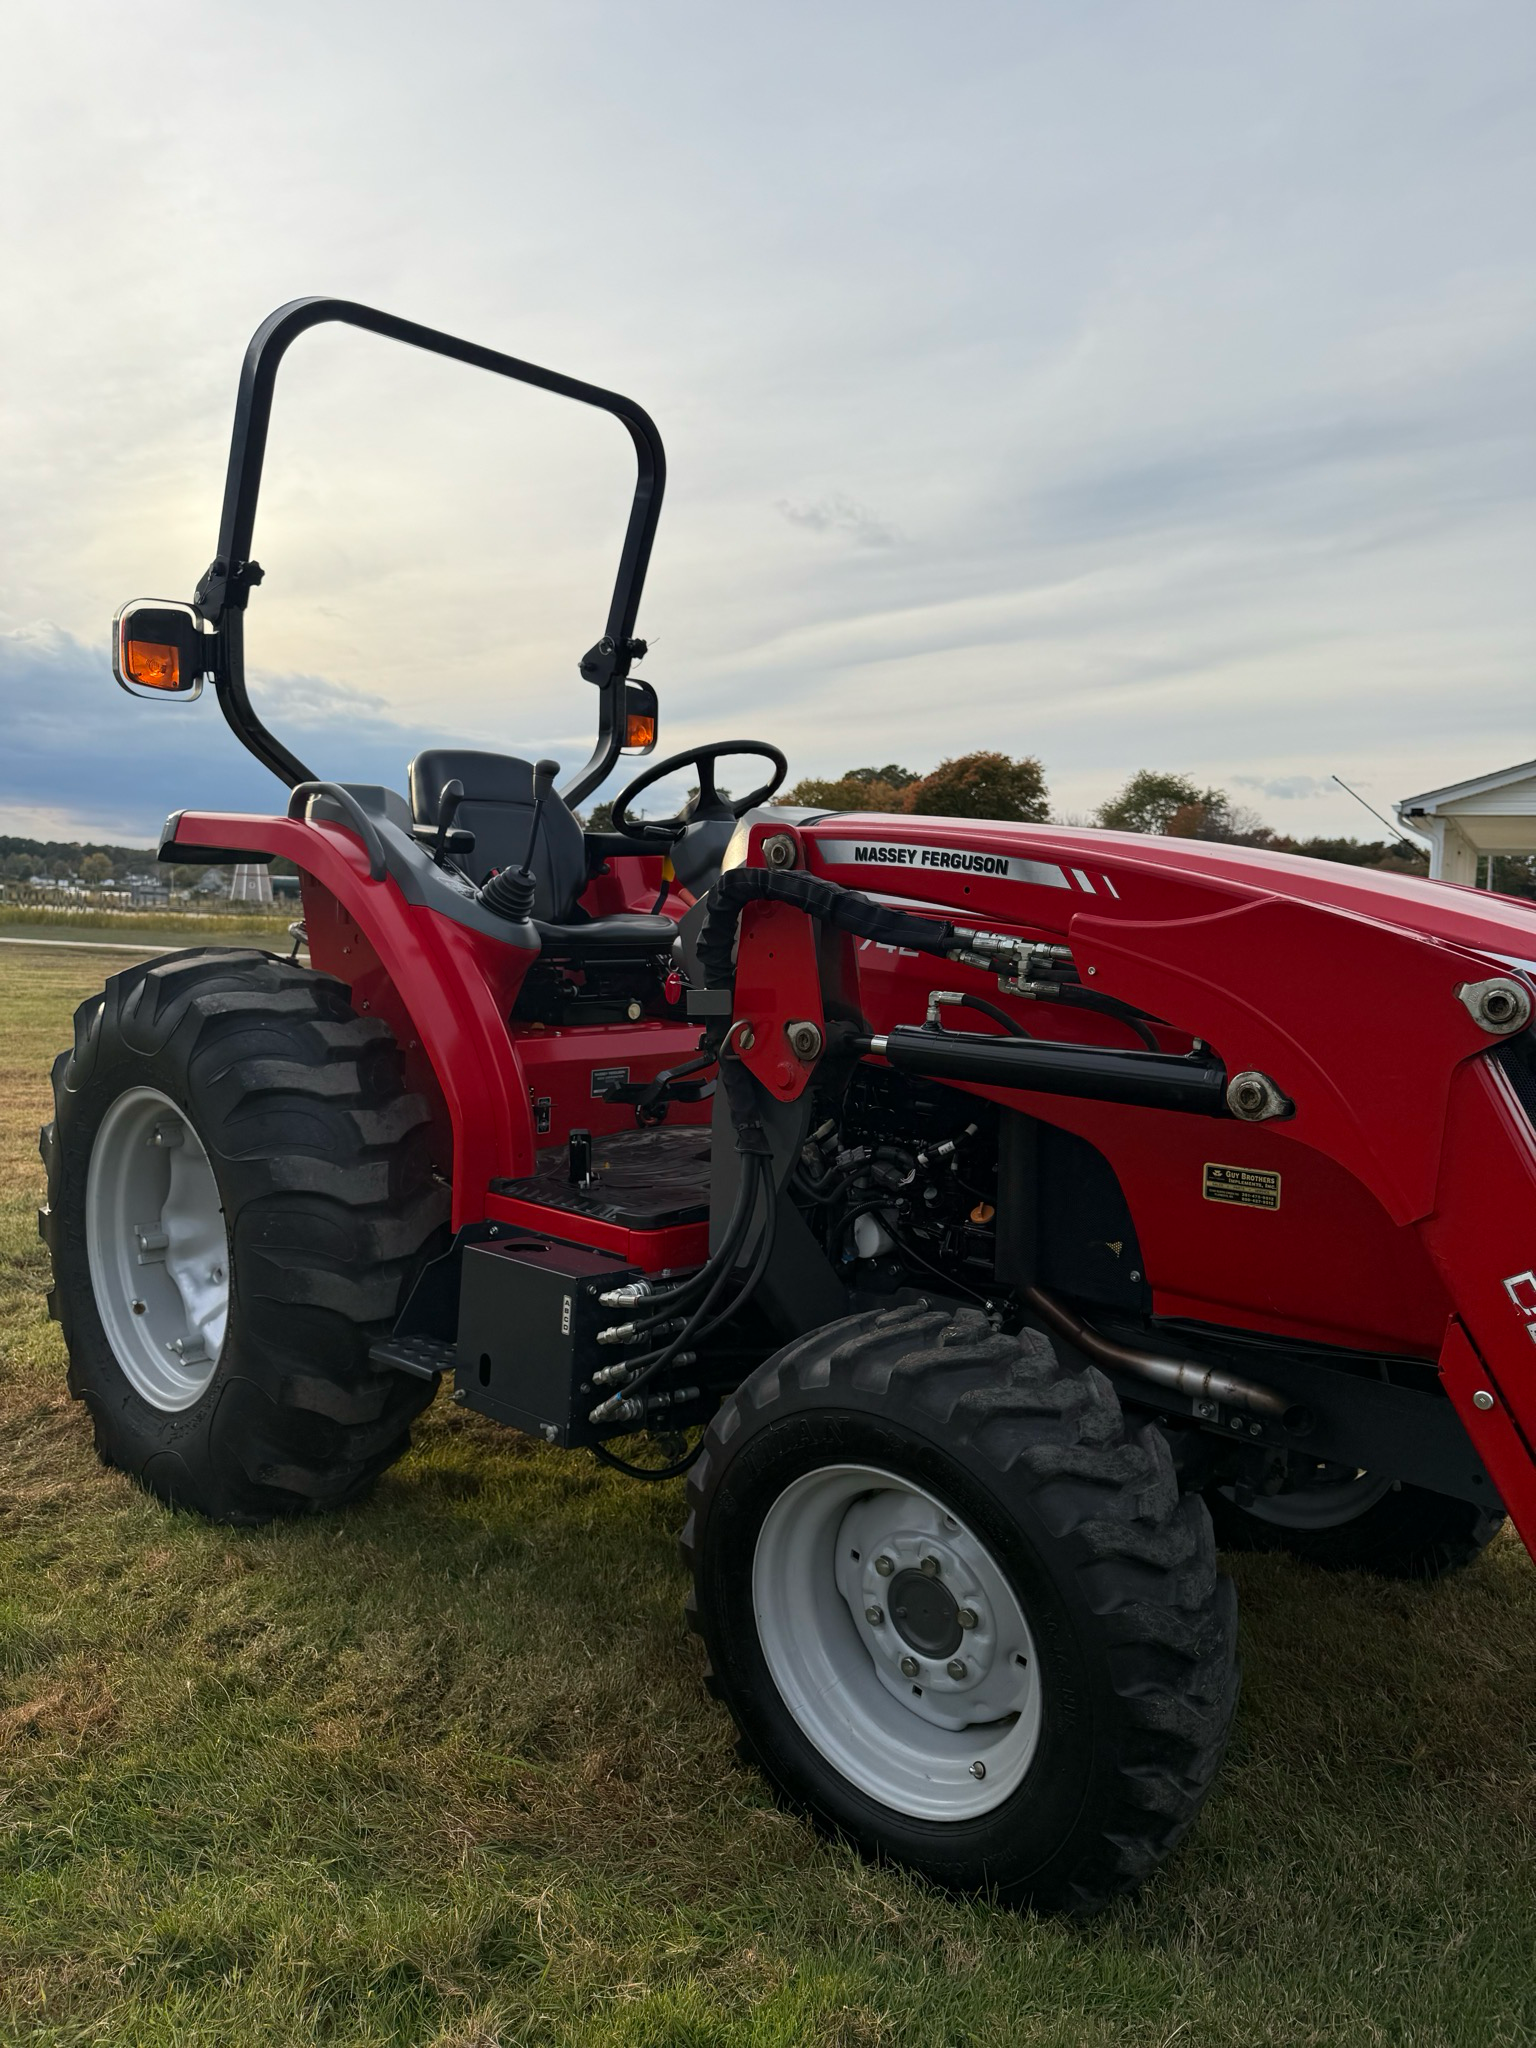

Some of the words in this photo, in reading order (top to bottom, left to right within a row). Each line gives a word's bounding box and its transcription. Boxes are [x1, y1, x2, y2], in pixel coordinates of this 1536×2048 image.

[855, 846, 917, 864] MASSEY
[921, 850, 1009, 876] FERGUSON
[1225, 1170, 1240, 1178] GUY
[1241, 1173, 1275, 1184] BROTHERS
